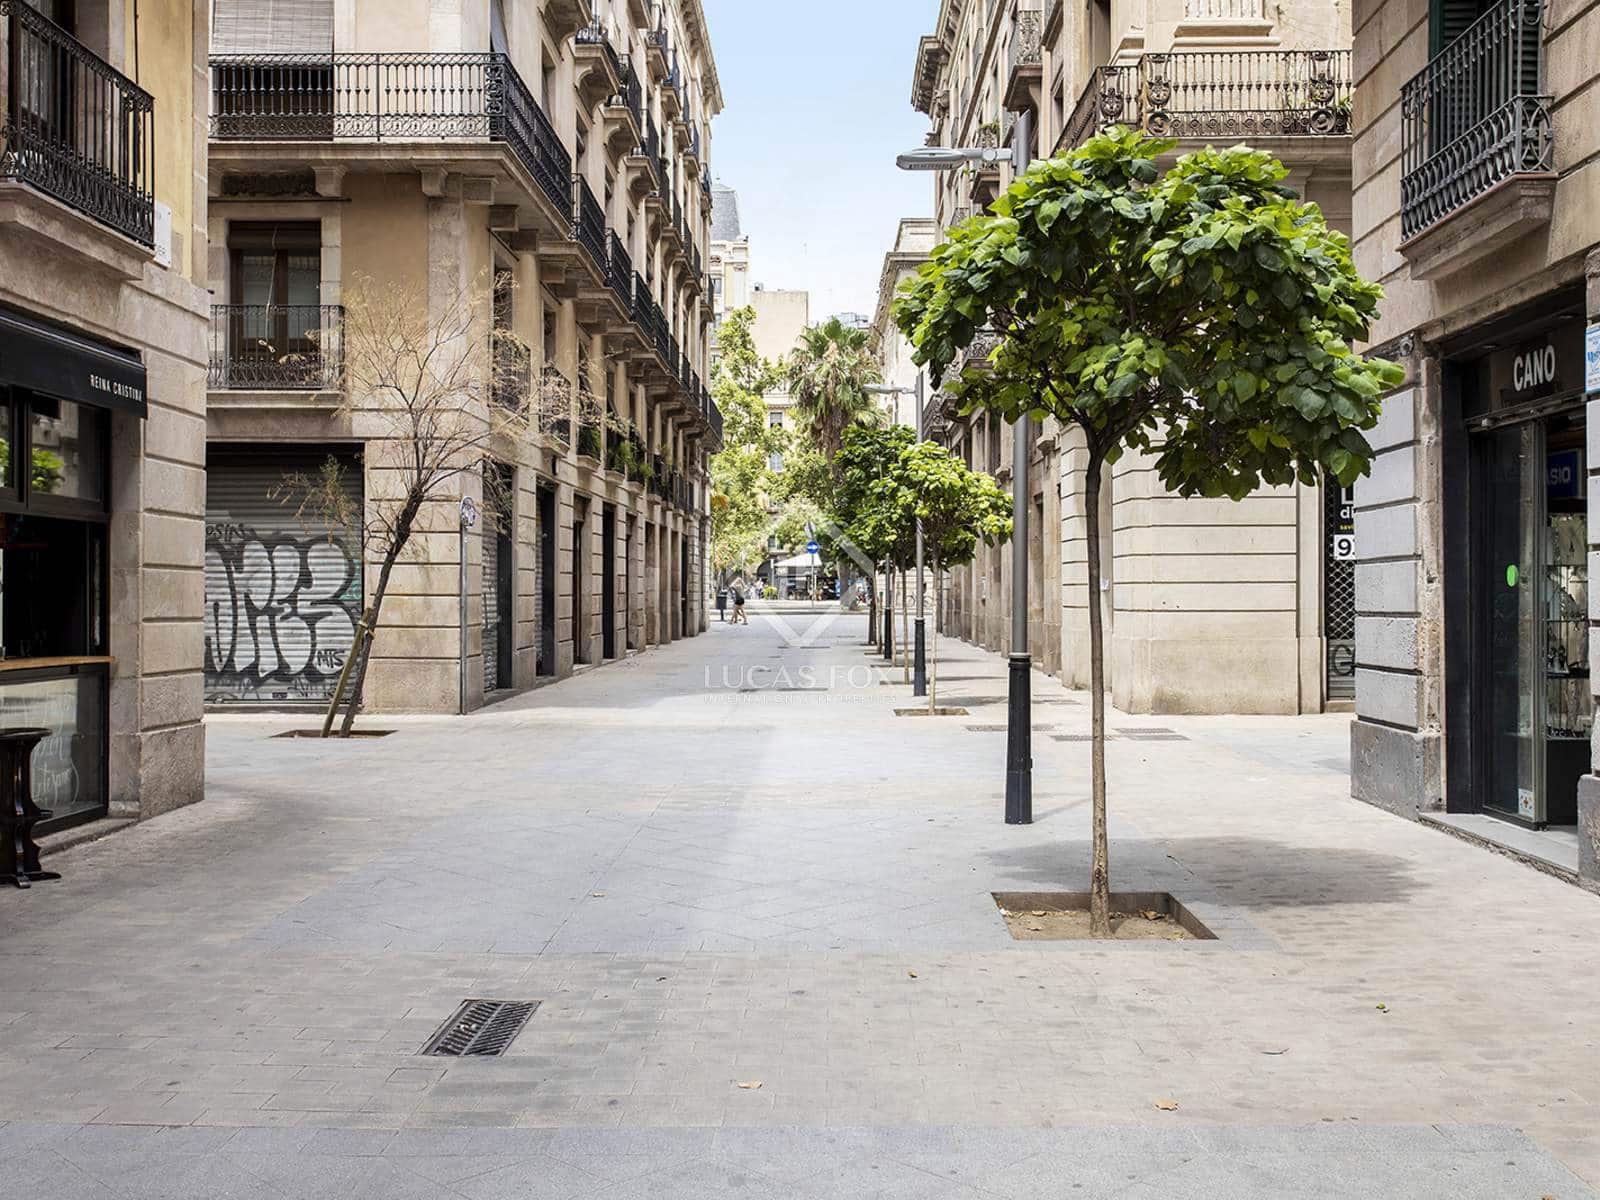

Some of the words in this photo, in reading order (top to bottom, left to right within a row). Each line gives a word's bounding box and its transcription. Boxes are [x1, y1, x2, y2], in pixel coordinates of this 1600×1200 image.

[1513, 345, 1555, 391] CANO
[90, 374, 111, 392] REINA
[113, 382, 143, 402] CRISTINA
[1338, 538, 1351, 556] 9
